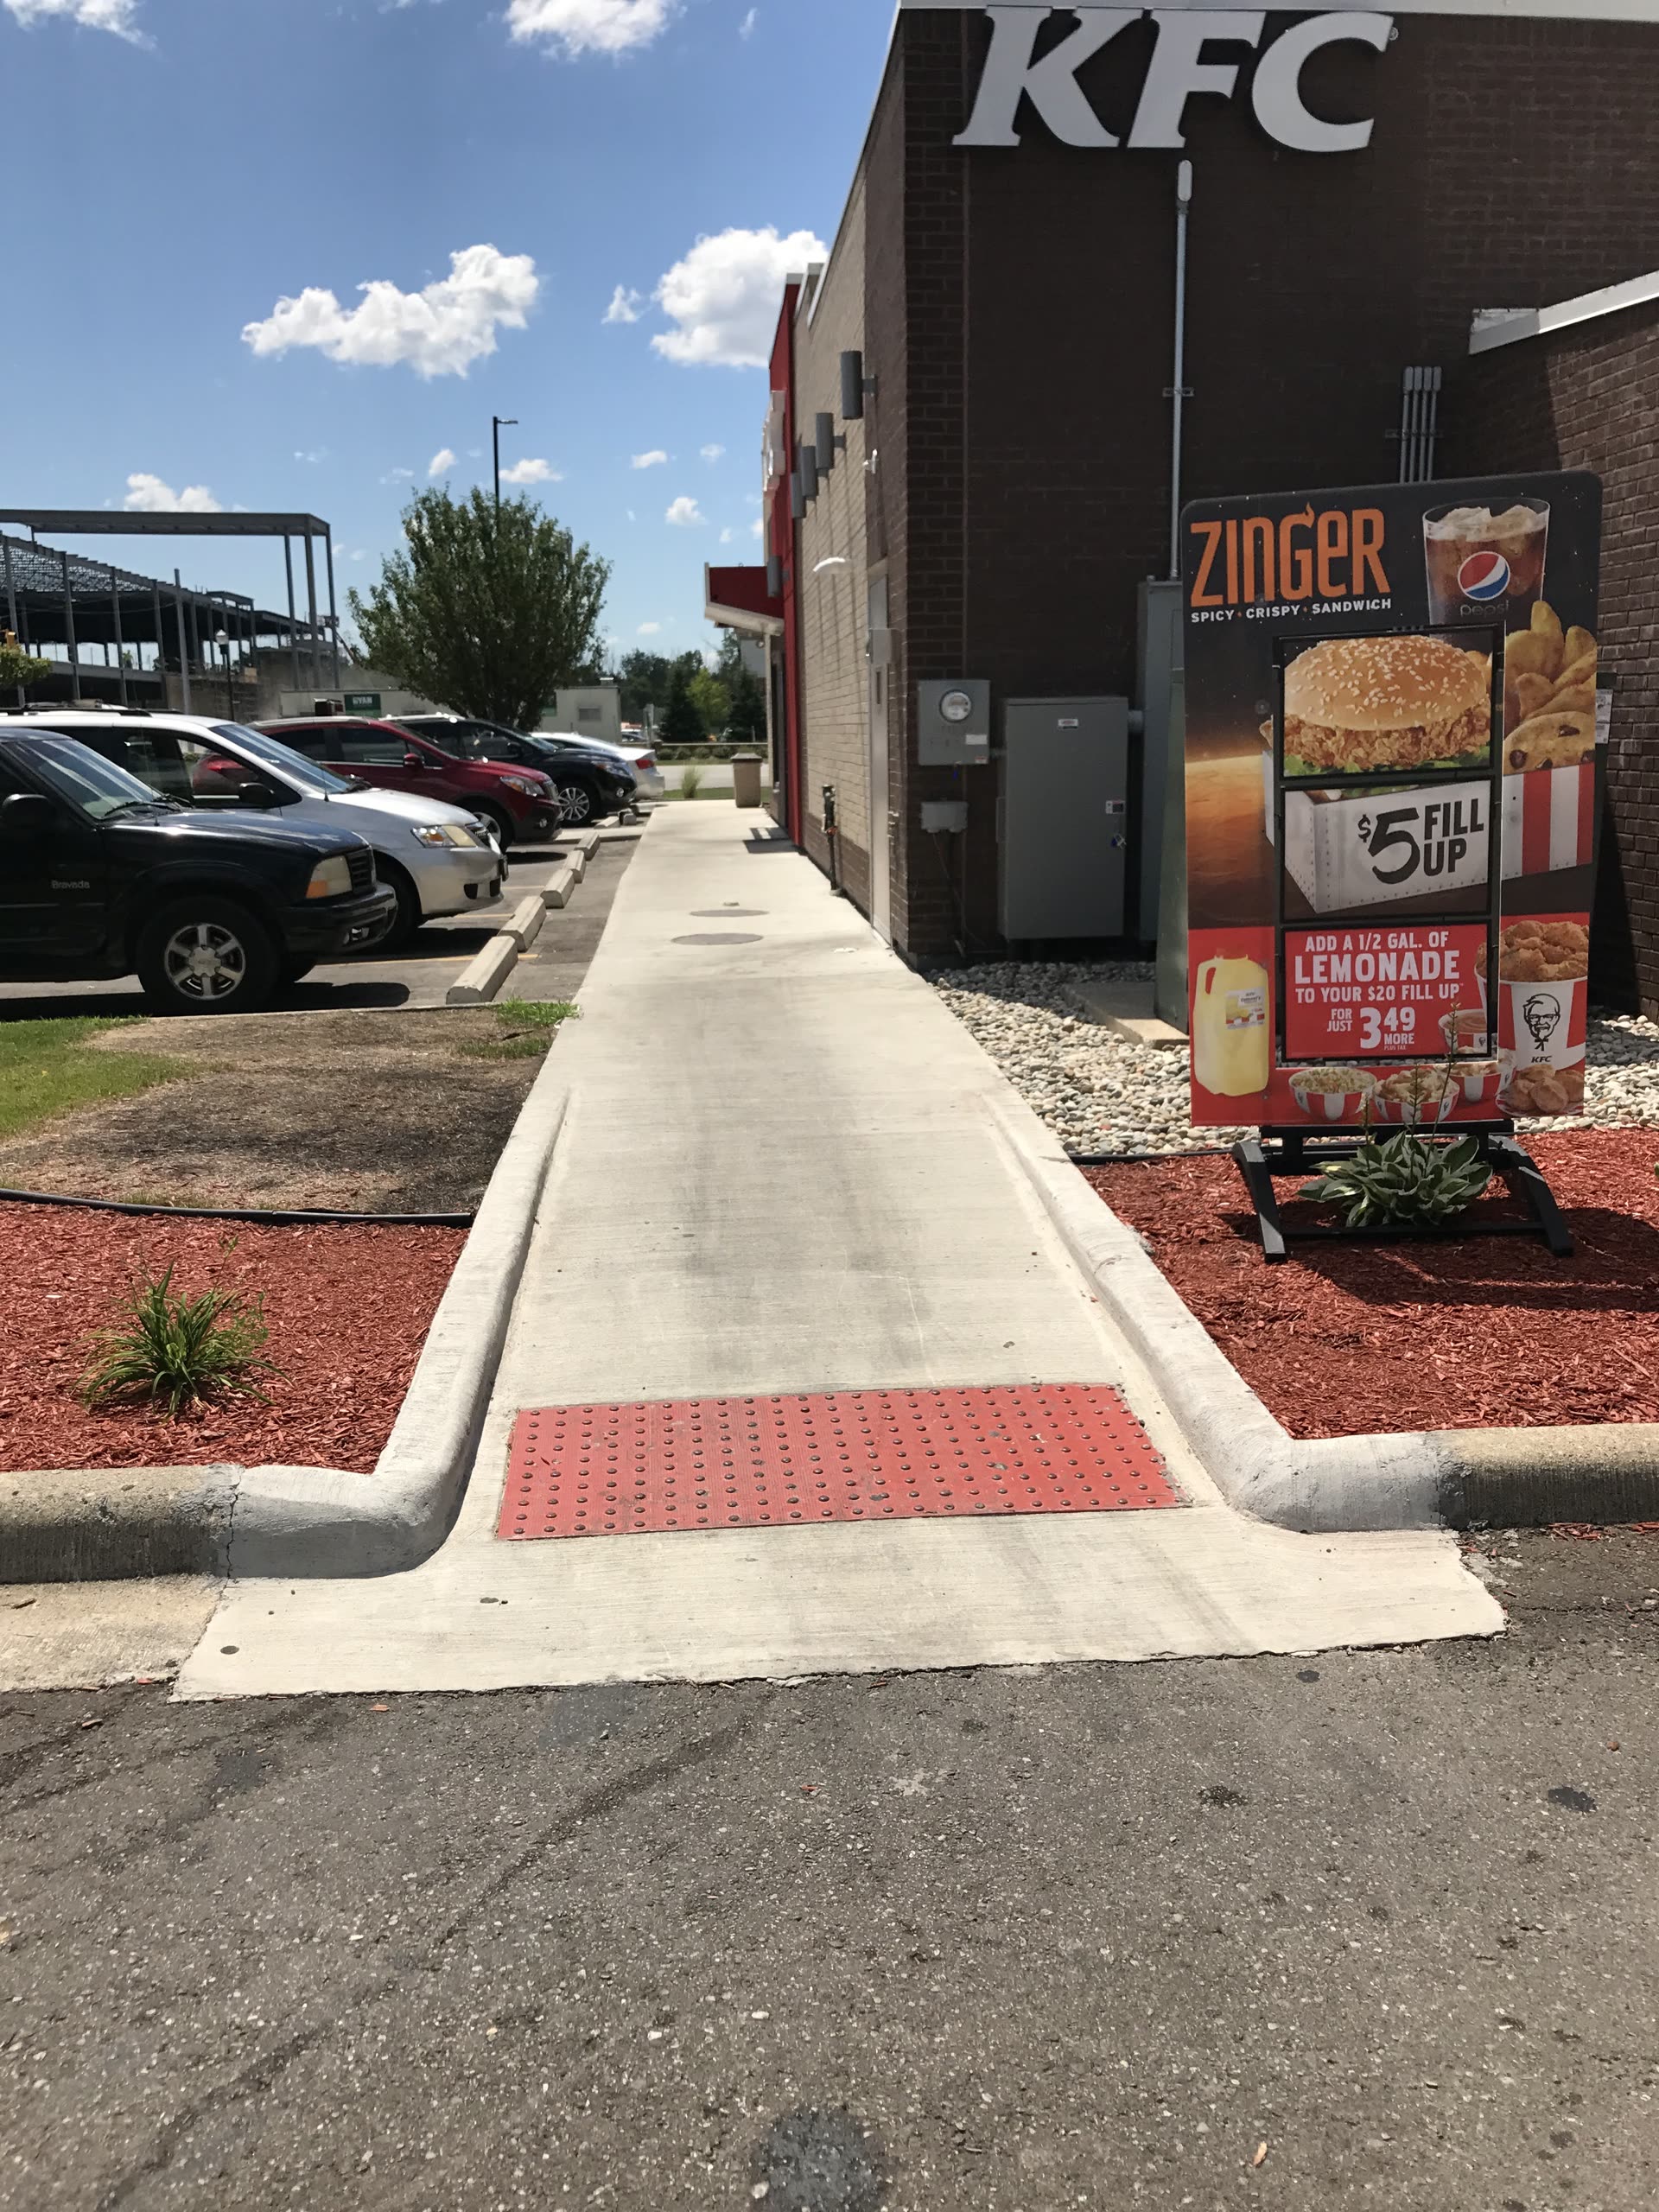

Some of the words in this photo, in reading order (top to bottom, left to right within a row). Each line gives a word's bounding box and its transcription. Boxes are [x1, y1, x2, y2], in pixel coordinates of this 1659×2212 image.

[952, 5, 1394, 153] KFC
[1191, 610, 1235, 623] SPICY
[1246, 605, 1300, 620] CRISPY
[1312, 598, 1392, 614] SANDWICH
[1424, 798, 1484, 841] FILL
[1423, 837, 1467, 877] UP
[1306, 935, 1337, 952] ADD
[1343, 934, 1353, 950] A
[1359, 932, 1382, 950] 1/2
[1387, 932, 1422, 950] GAL.
[1428, 931, 1449, 948] OF
[1294, 950, 1460, 984] LEMONADE
[1295, 988, 1315, 1003] TO
[1320, 986, 1362, 1003] YOUR
[1368, 984, 1396, 1002] $20
[1402, 983, 1433, 1001] FILL
[1439, 982, 1460, 999] UP
[1331, 1007, 1352, 1020] FOR
[1326, 1020, 1352, 1032] JUST
[1384, 1033, 1415, 1046] MORE
[1531, 1055, 1552, 1064] KFC
